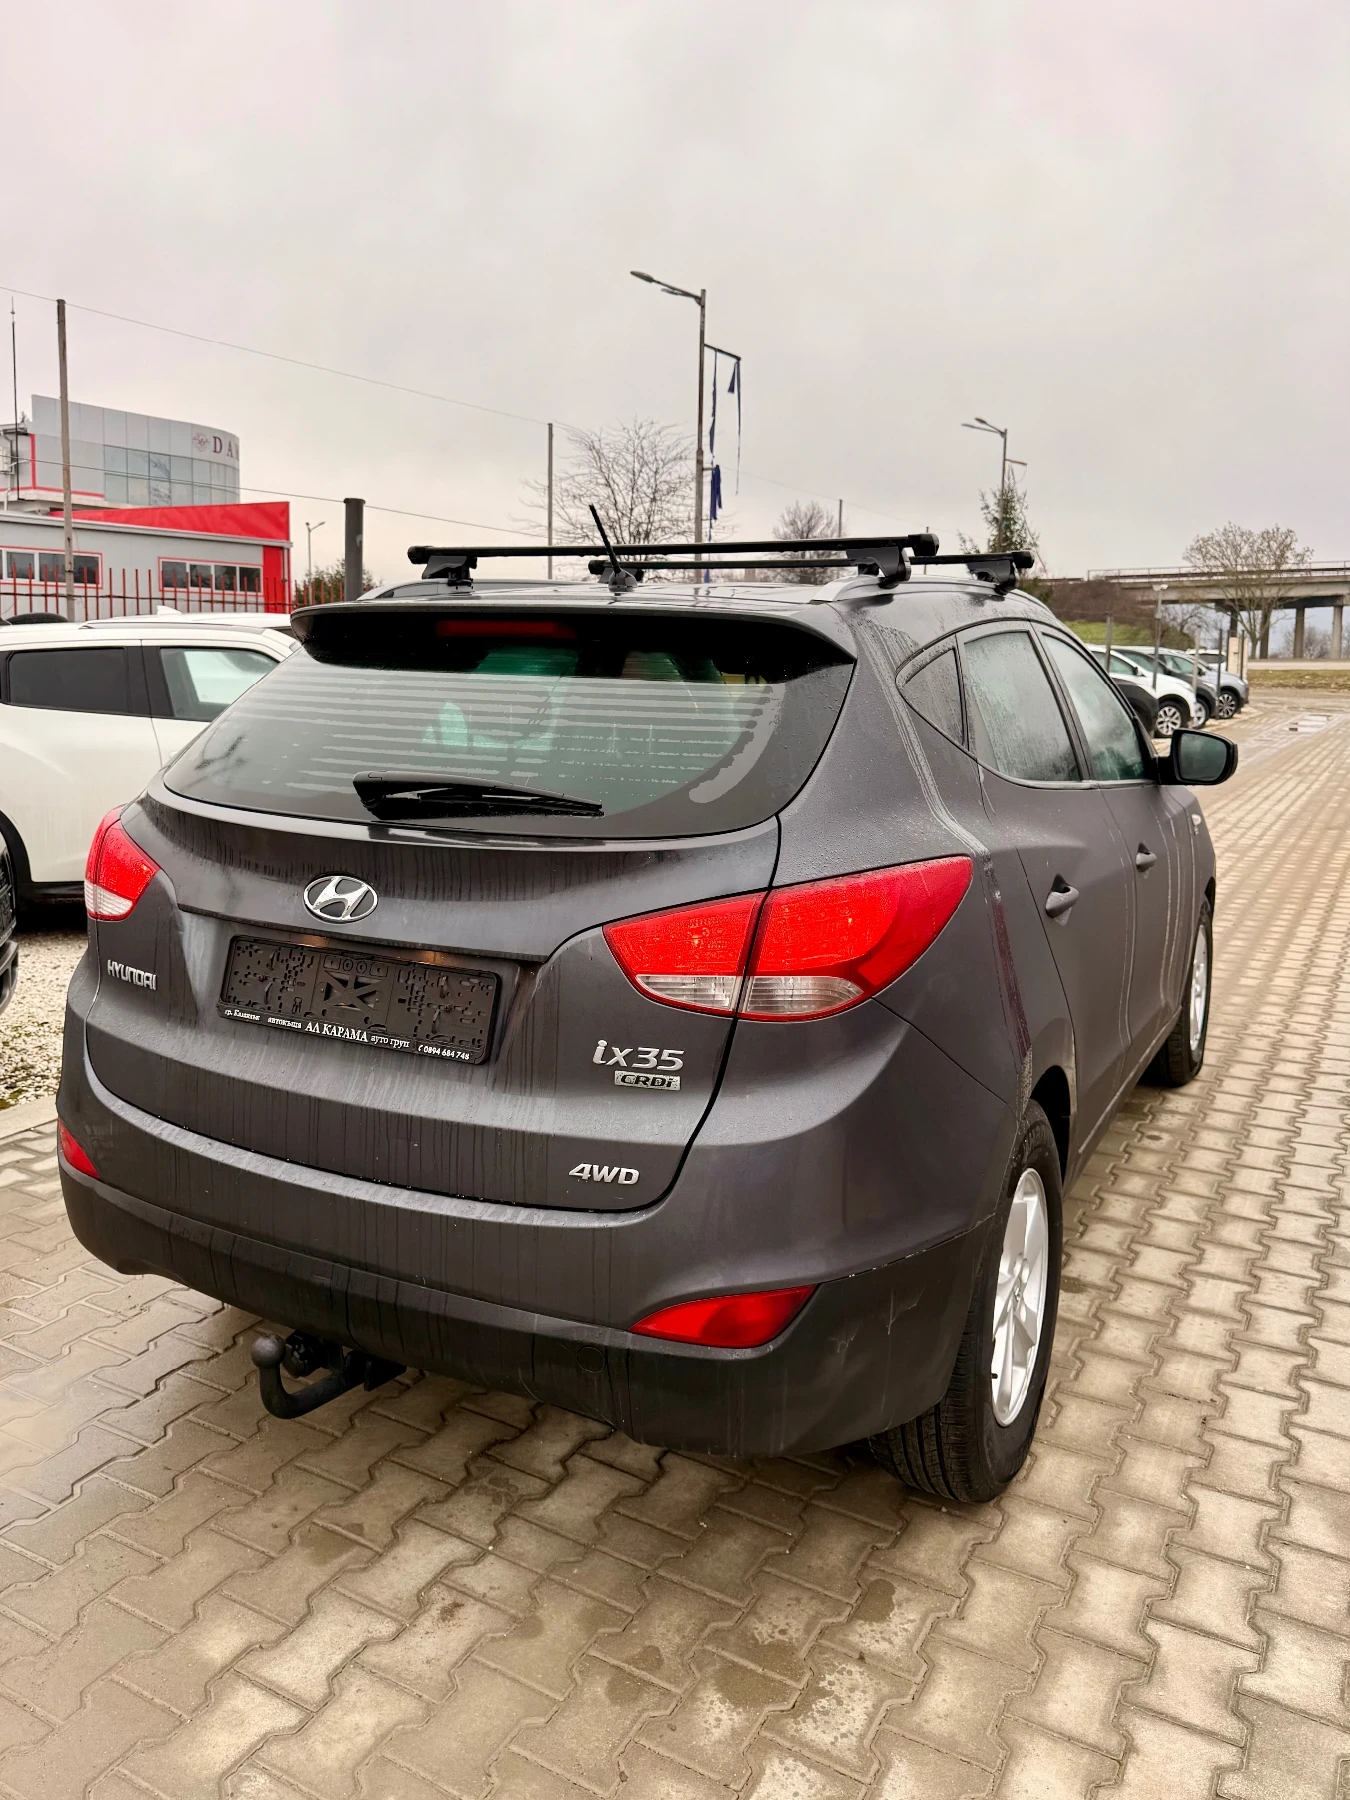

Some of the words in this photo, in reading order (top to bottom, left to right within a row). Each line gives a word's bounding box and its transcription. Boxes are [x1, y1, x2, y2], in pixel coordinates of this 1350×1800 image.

[107, 959, 157, 991] HYUNDAI
[304, 1021, 321, 1034] АЛ
[322, 1023, 368, 1042] КАРАМА
[370, 1034, 389, 1045] ауто
[389, 1038, 411, 1049] груп
[423, 1045, 441, 1055] 0894
[592, 1039, 685, 1071] ix35
[620, 1074, 674, 1088] CRDi
[568, 1162, 640, 1185] 4WD
